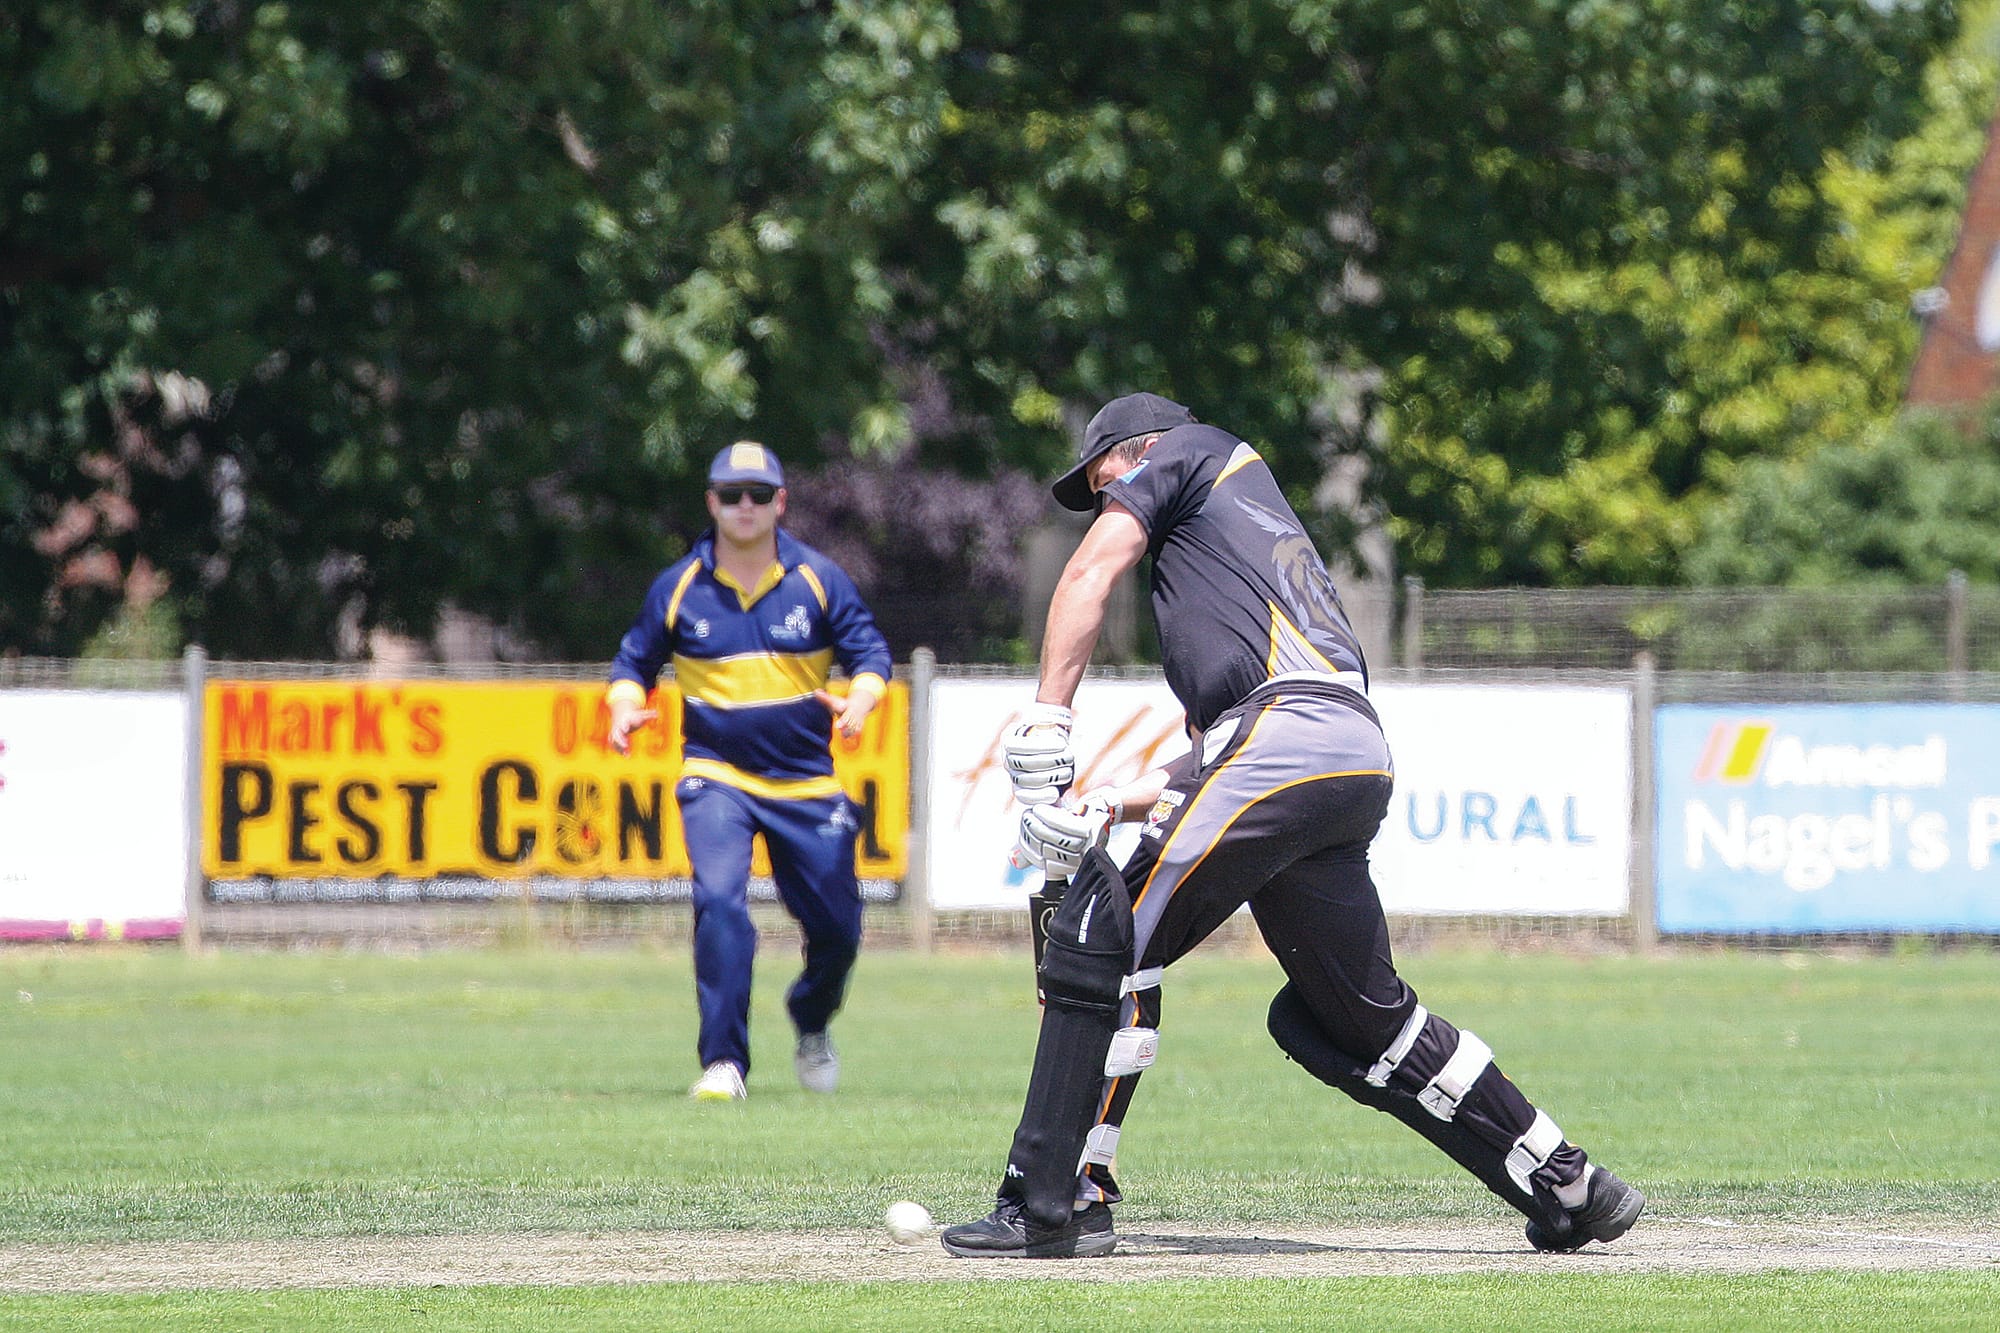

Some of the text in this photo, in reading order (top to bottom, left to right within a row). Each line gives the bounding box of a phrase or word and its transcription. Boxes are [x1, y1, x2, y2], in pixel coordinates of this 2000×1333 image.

[220, 687, 445, 753] Mark's
[220, 764, 437, 862] PEST
[1407, 790, 1599, 843] URAL
[1686, 794, 1949, 890] Nagel's
